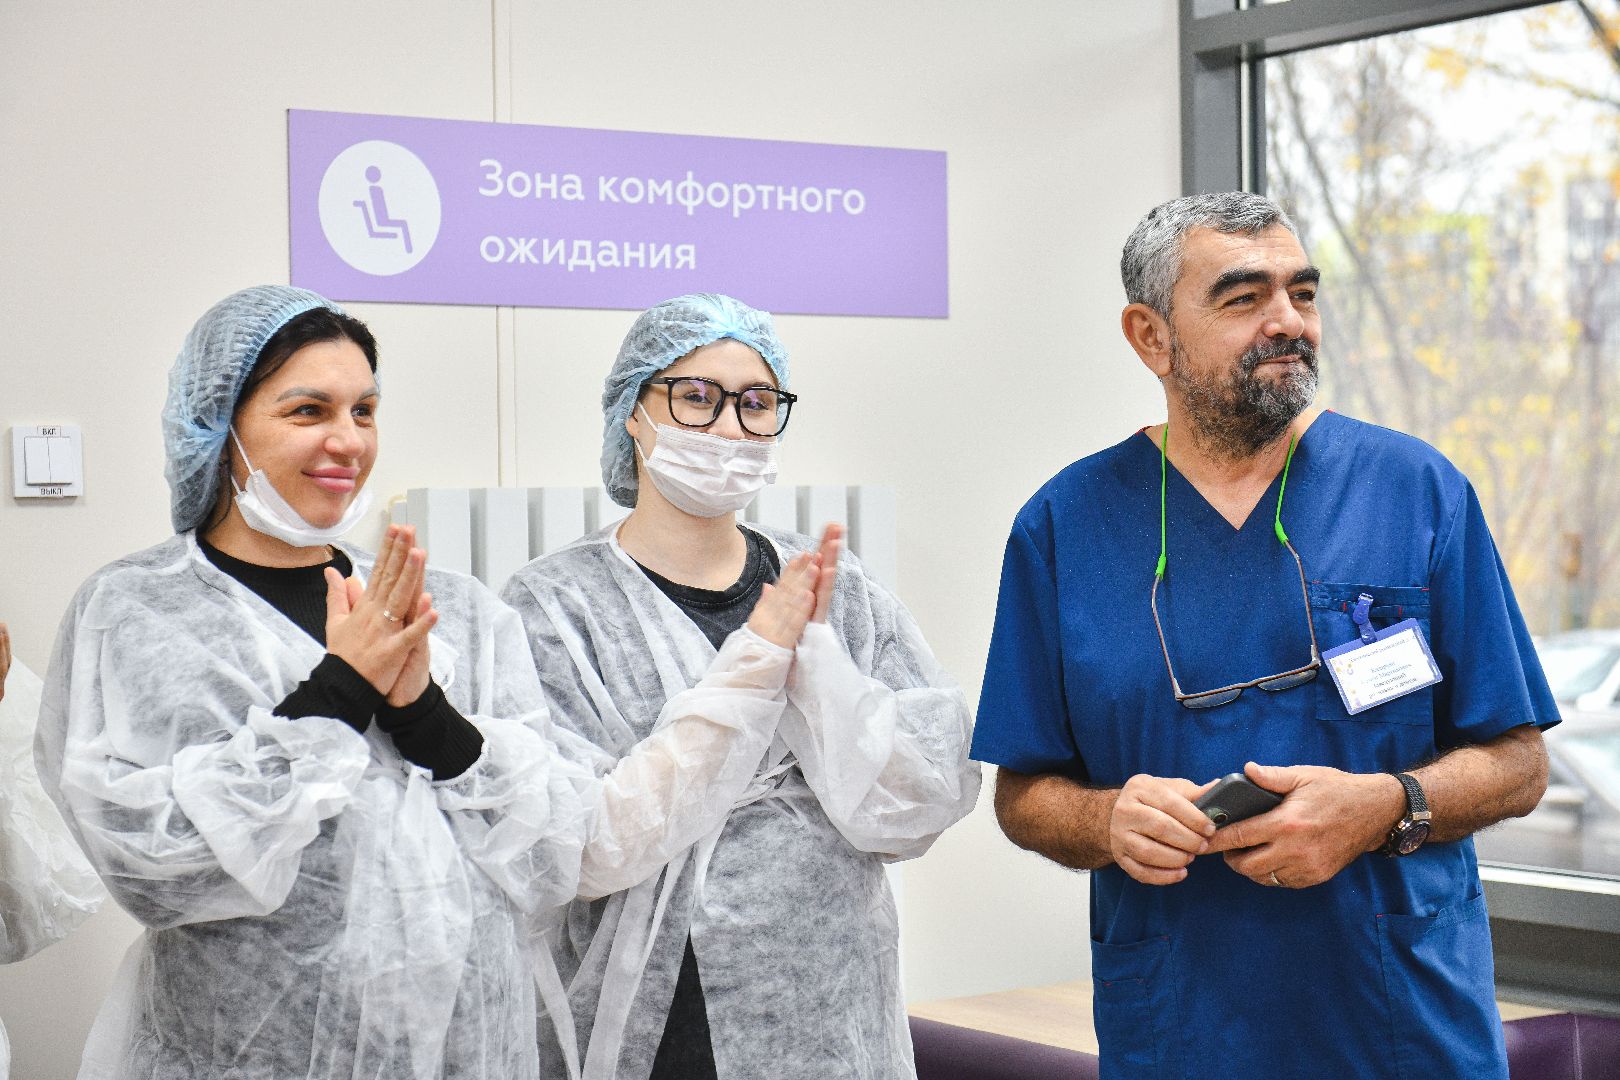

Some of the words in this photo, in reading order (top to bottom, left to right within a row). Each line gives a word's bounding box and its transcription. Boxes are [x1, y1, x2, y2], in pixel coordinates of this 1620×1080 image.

[478, 158, 586, 202] Зона
[598, 169, 867, 219] комфортного
[479, 234, 698, 273] ожидания
[40, 487, 63, 496] ВЫКЛ
